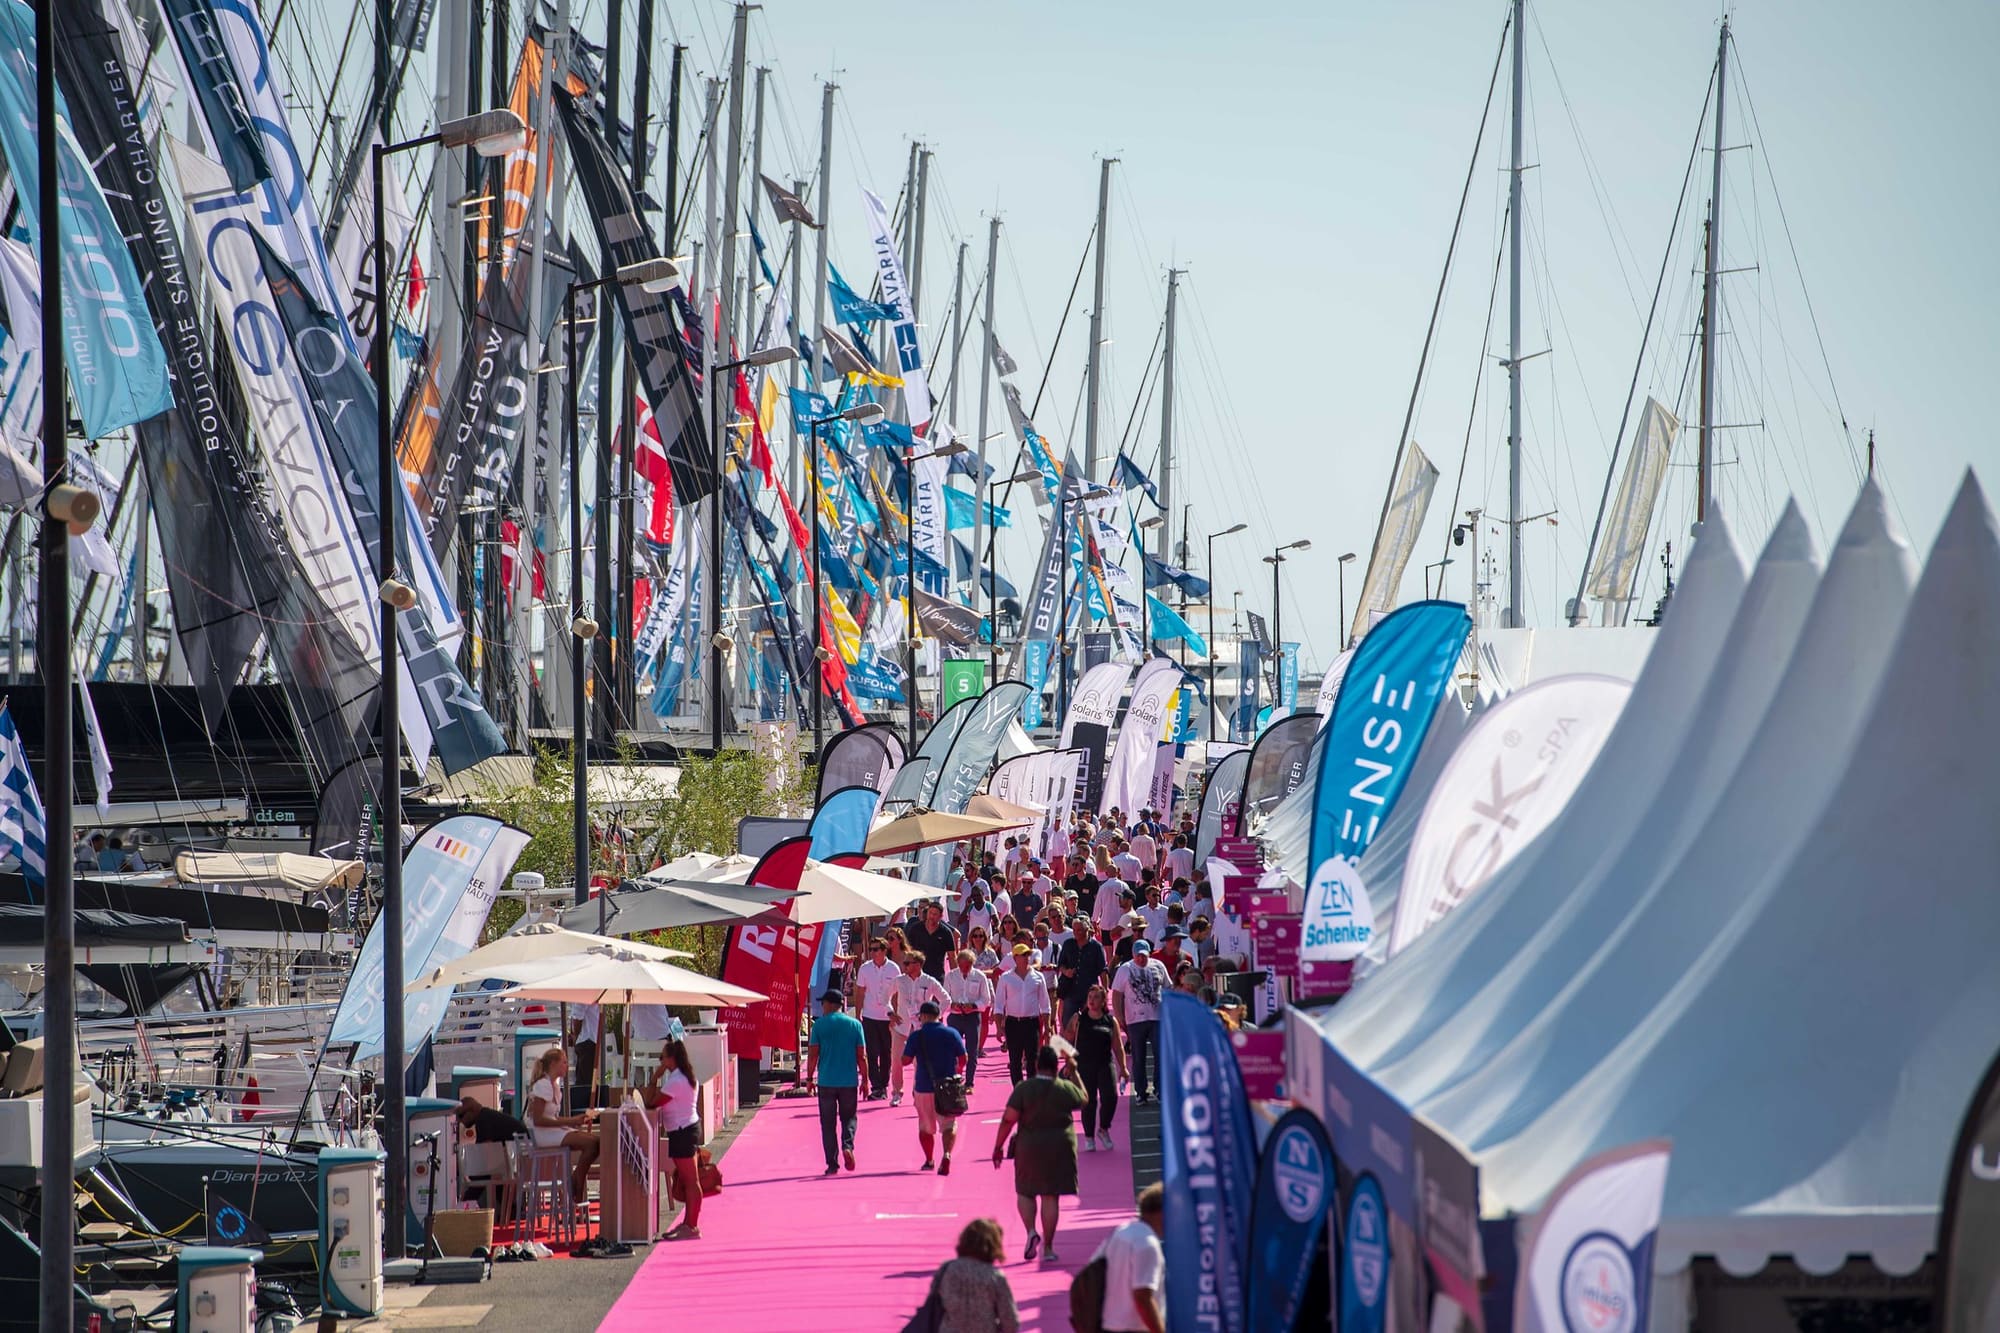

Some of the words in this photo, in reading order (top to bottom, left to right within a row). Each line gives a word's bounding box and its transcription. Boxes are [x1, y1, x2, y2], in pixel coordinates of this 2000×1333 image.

[104, 59, 155, 185] CHARTER
[146, 198, 188, 303] SAILING
[177, 316, 219, 450] BOUTIQUE
[918, 481, 936, 555] AVARIA
[640, 566, 684, 648] BAVARIA
[958, 678, 969, 693] 5
[1072, 703, 1103, 720] solaris
[1130, 706, 1160, 725] solaris
[1341, 673, 1416, 868] ENSE
[255, 809, 296, 822] diem
[1320, 880, 1353, 912] ZEN
[1305, 919, 1371, 948] Schenker
[212, 1169, 279, 1184] Django
